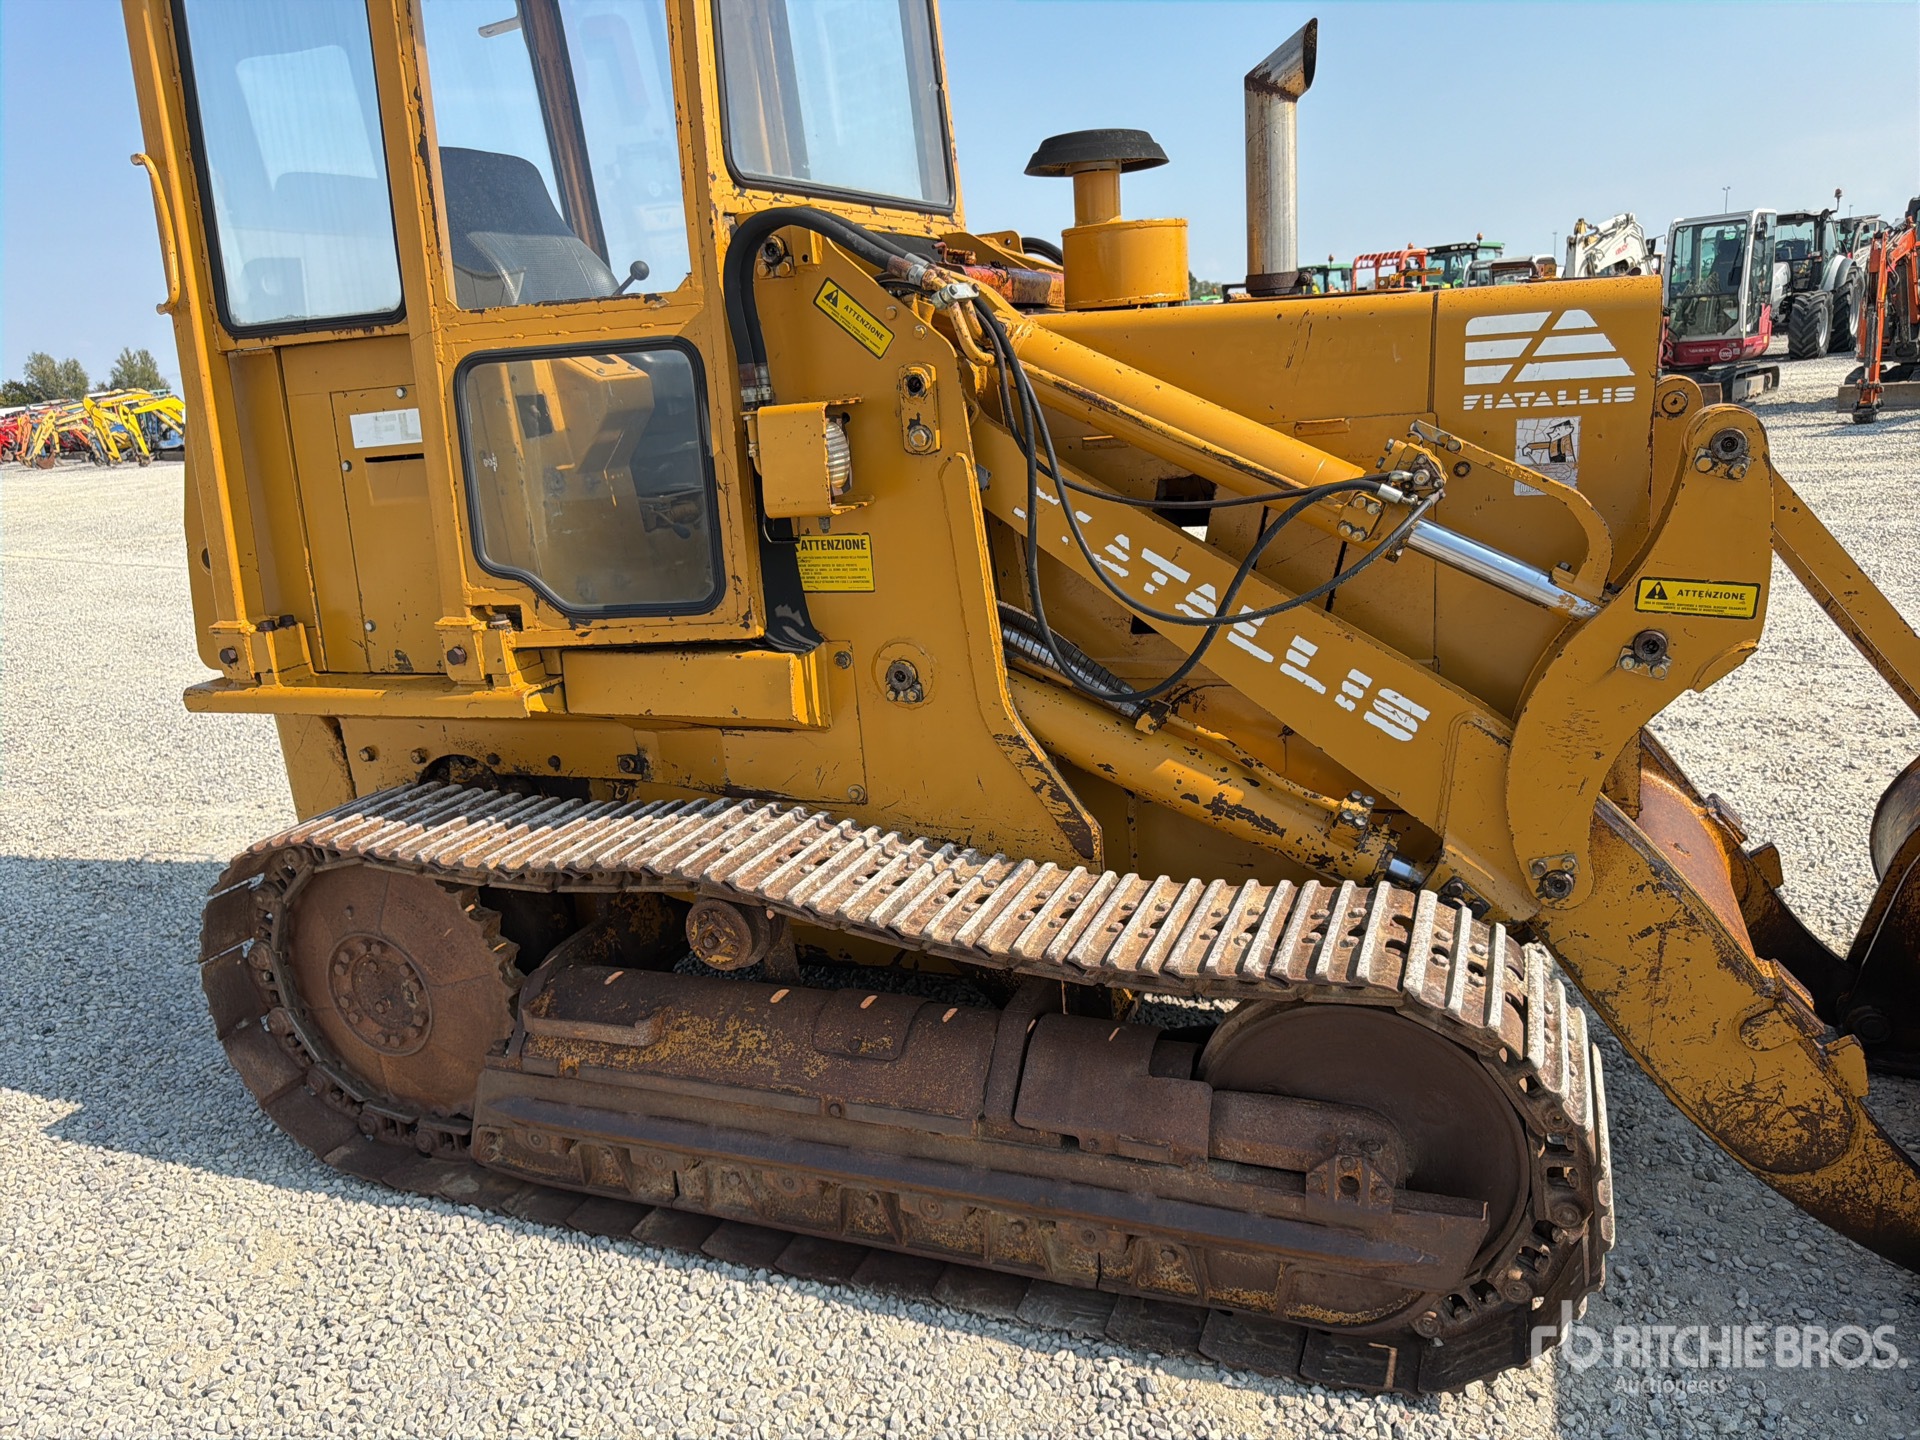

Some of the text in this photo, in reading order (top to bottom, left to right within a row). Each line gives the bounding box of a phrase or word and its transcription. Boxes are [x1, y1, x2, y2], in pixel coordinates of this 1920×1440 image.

[843, 304, 885, 341] ATTENZIONE
[1462, 386, 1636, 411] FIATALLIS
[800, 538, 867, 551] ATTENZIONE
[1676, 588, 1747, 601] ATTENZIONE
